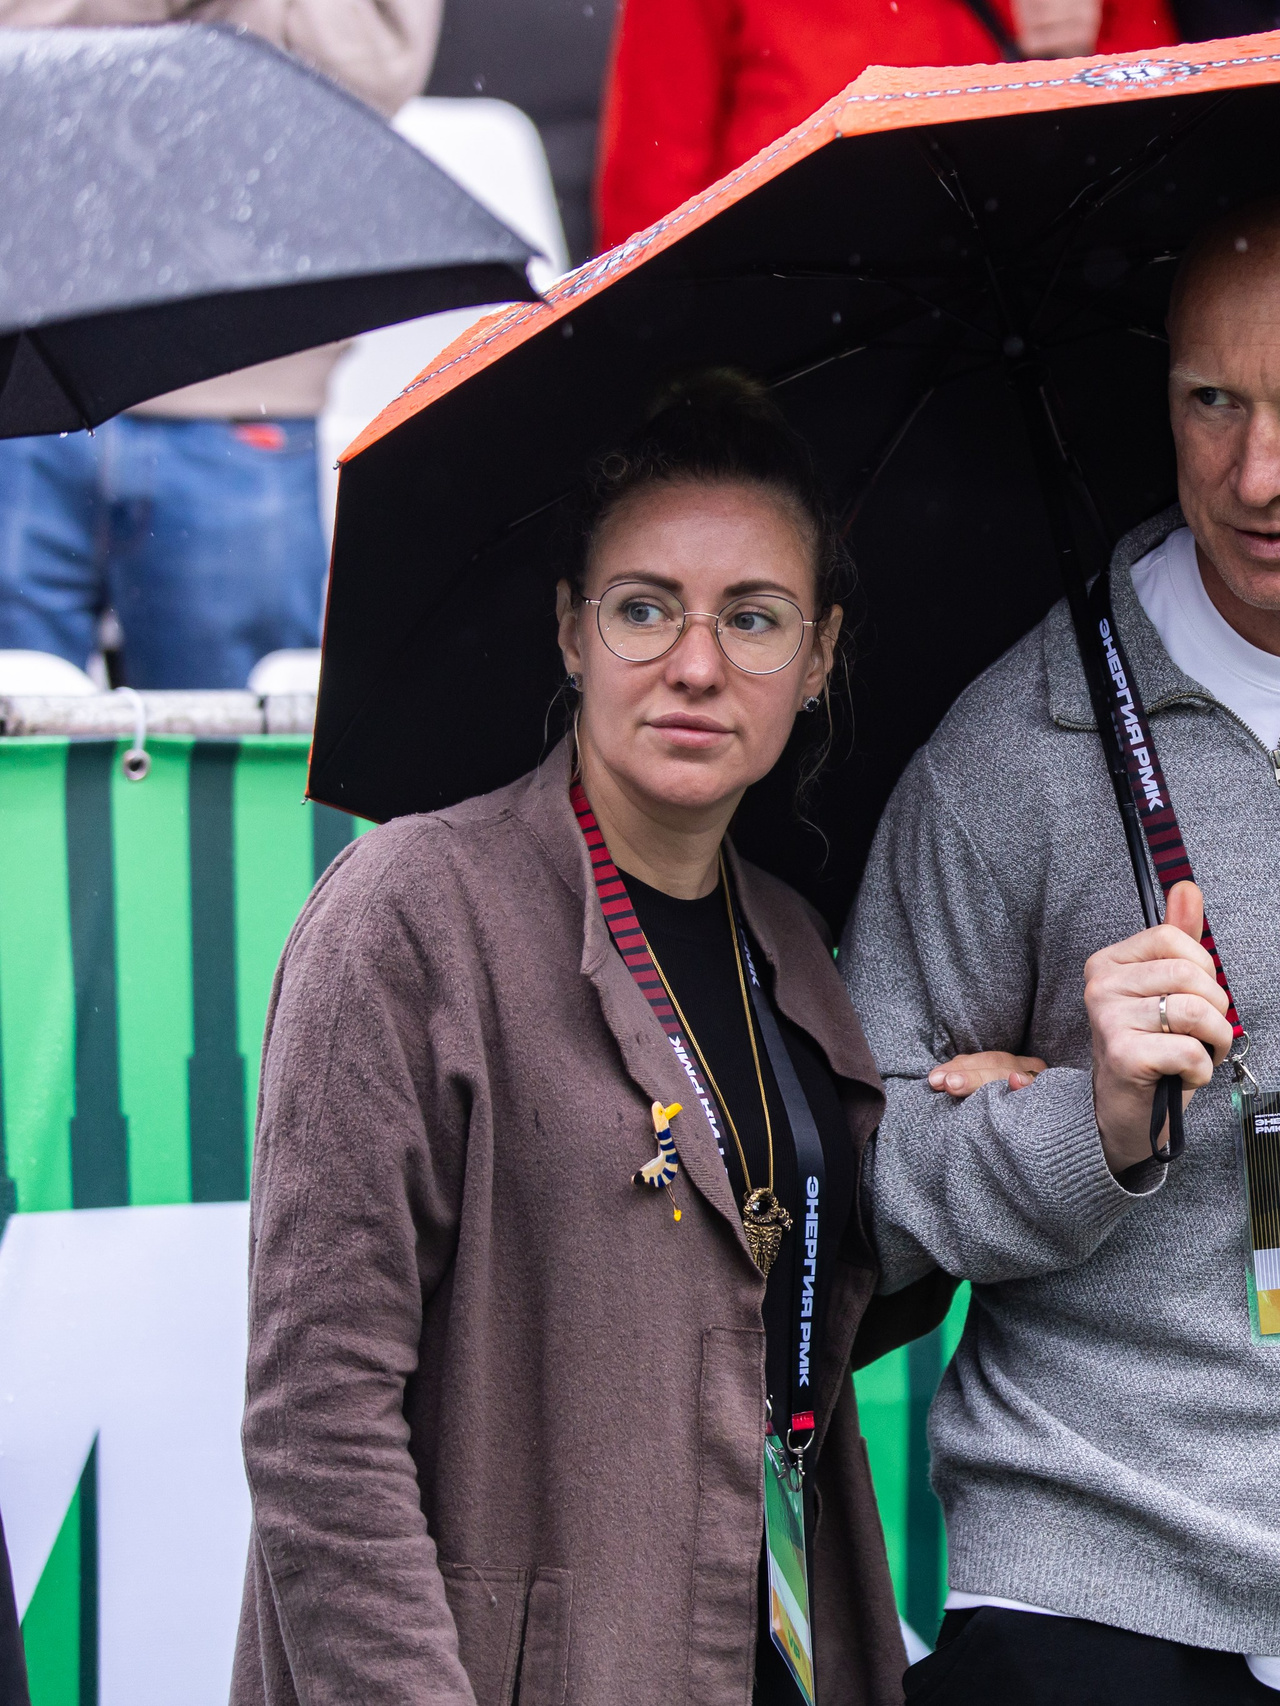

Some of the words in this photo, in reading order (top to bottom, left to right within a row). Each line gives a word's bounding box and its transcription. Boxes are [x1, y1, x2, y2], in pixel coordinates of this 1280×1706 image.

[1100, 618, 1144, 745] ЭНЕРГИЯ
[1133, 750, 1164, 811] РМК
[801, 1176, 819, 1317] ЭНЕРГИЯ
[799, 1322, 812, 1387] РМК
